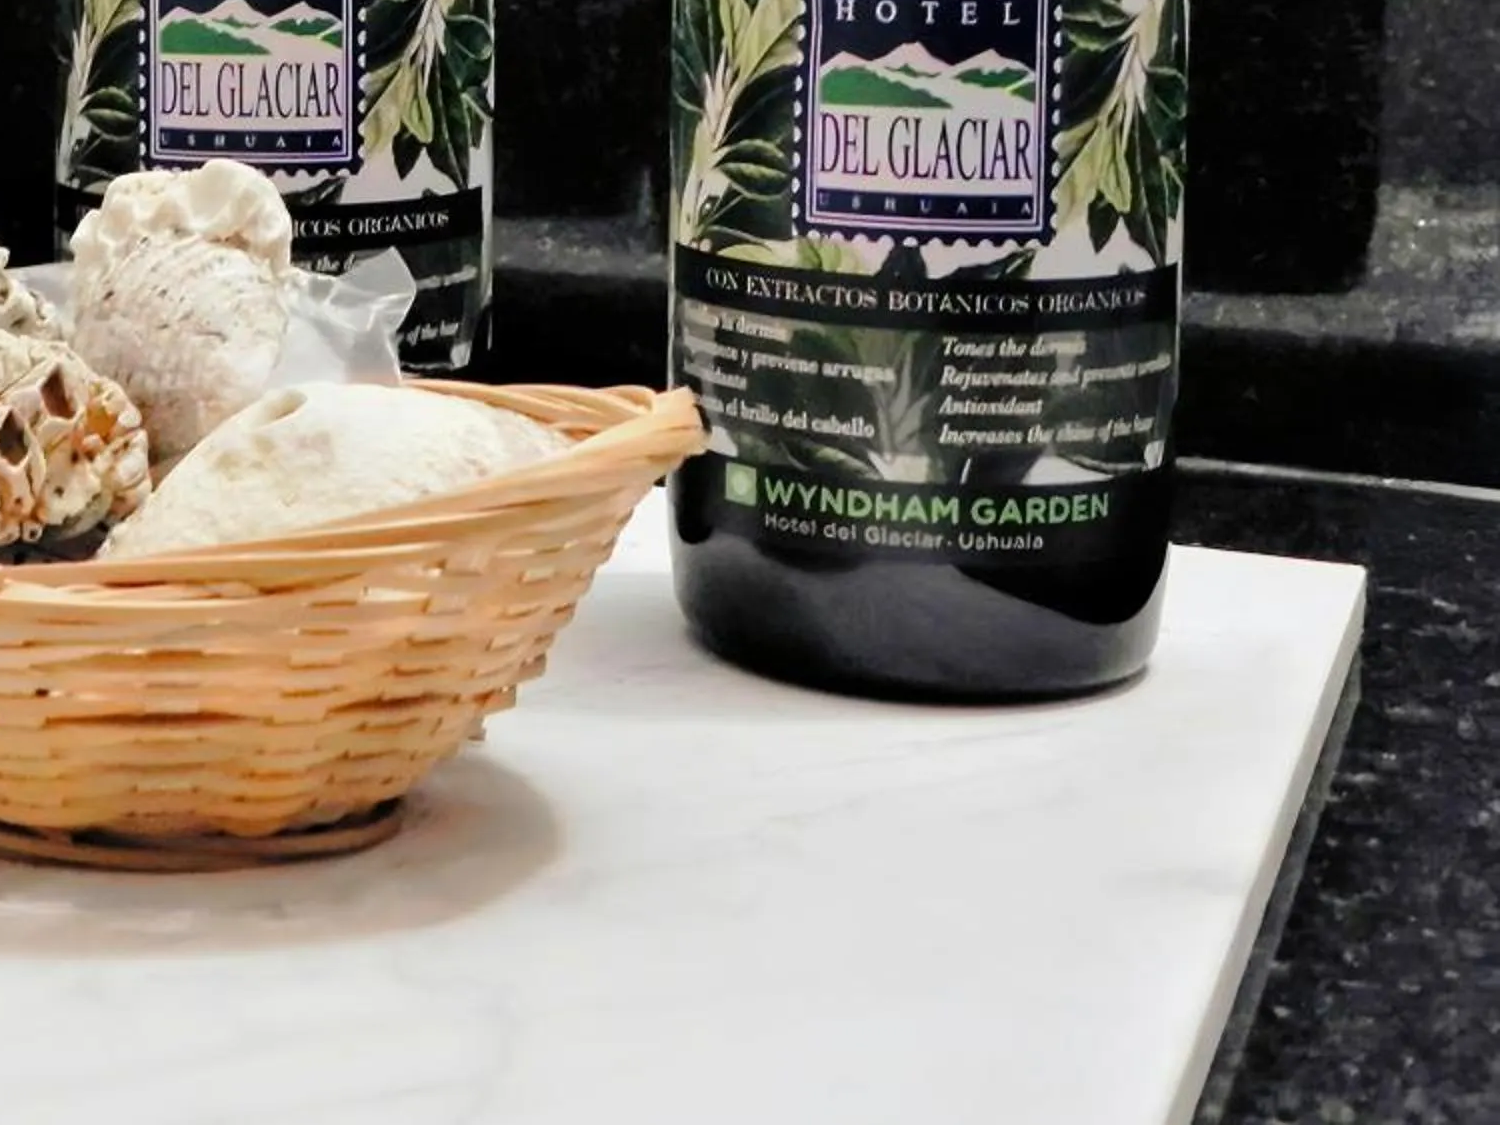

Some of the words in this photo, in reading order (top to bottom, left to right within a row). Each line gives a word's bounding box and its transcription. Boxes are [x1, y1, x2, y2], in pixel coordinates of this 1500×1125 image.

[160, 61, 211, 117] DEL
[217, 61, 342, 119] GLACIAR
[820, 113, 879, 176] DEL
[888, 115, 1033, 180] GLACIAR
[706, 267, 738, 290] CON
[747, 275, 877, 309] EXTRACTOS
[888, 289, 1029, 315] BOTANICOS
[942, 336, 995, 358] Tones
[999, 337, 1026, 357] the
[782, 409, 807, 430] del
[764, 476, 959, 526] WYNDHAM
[971, 492, 1110, 527] GARDEN
[765, 513, 816, 537] Hotel
[823, 522, 856, 540] del
[864, 526, 943, 550] Glaciar
